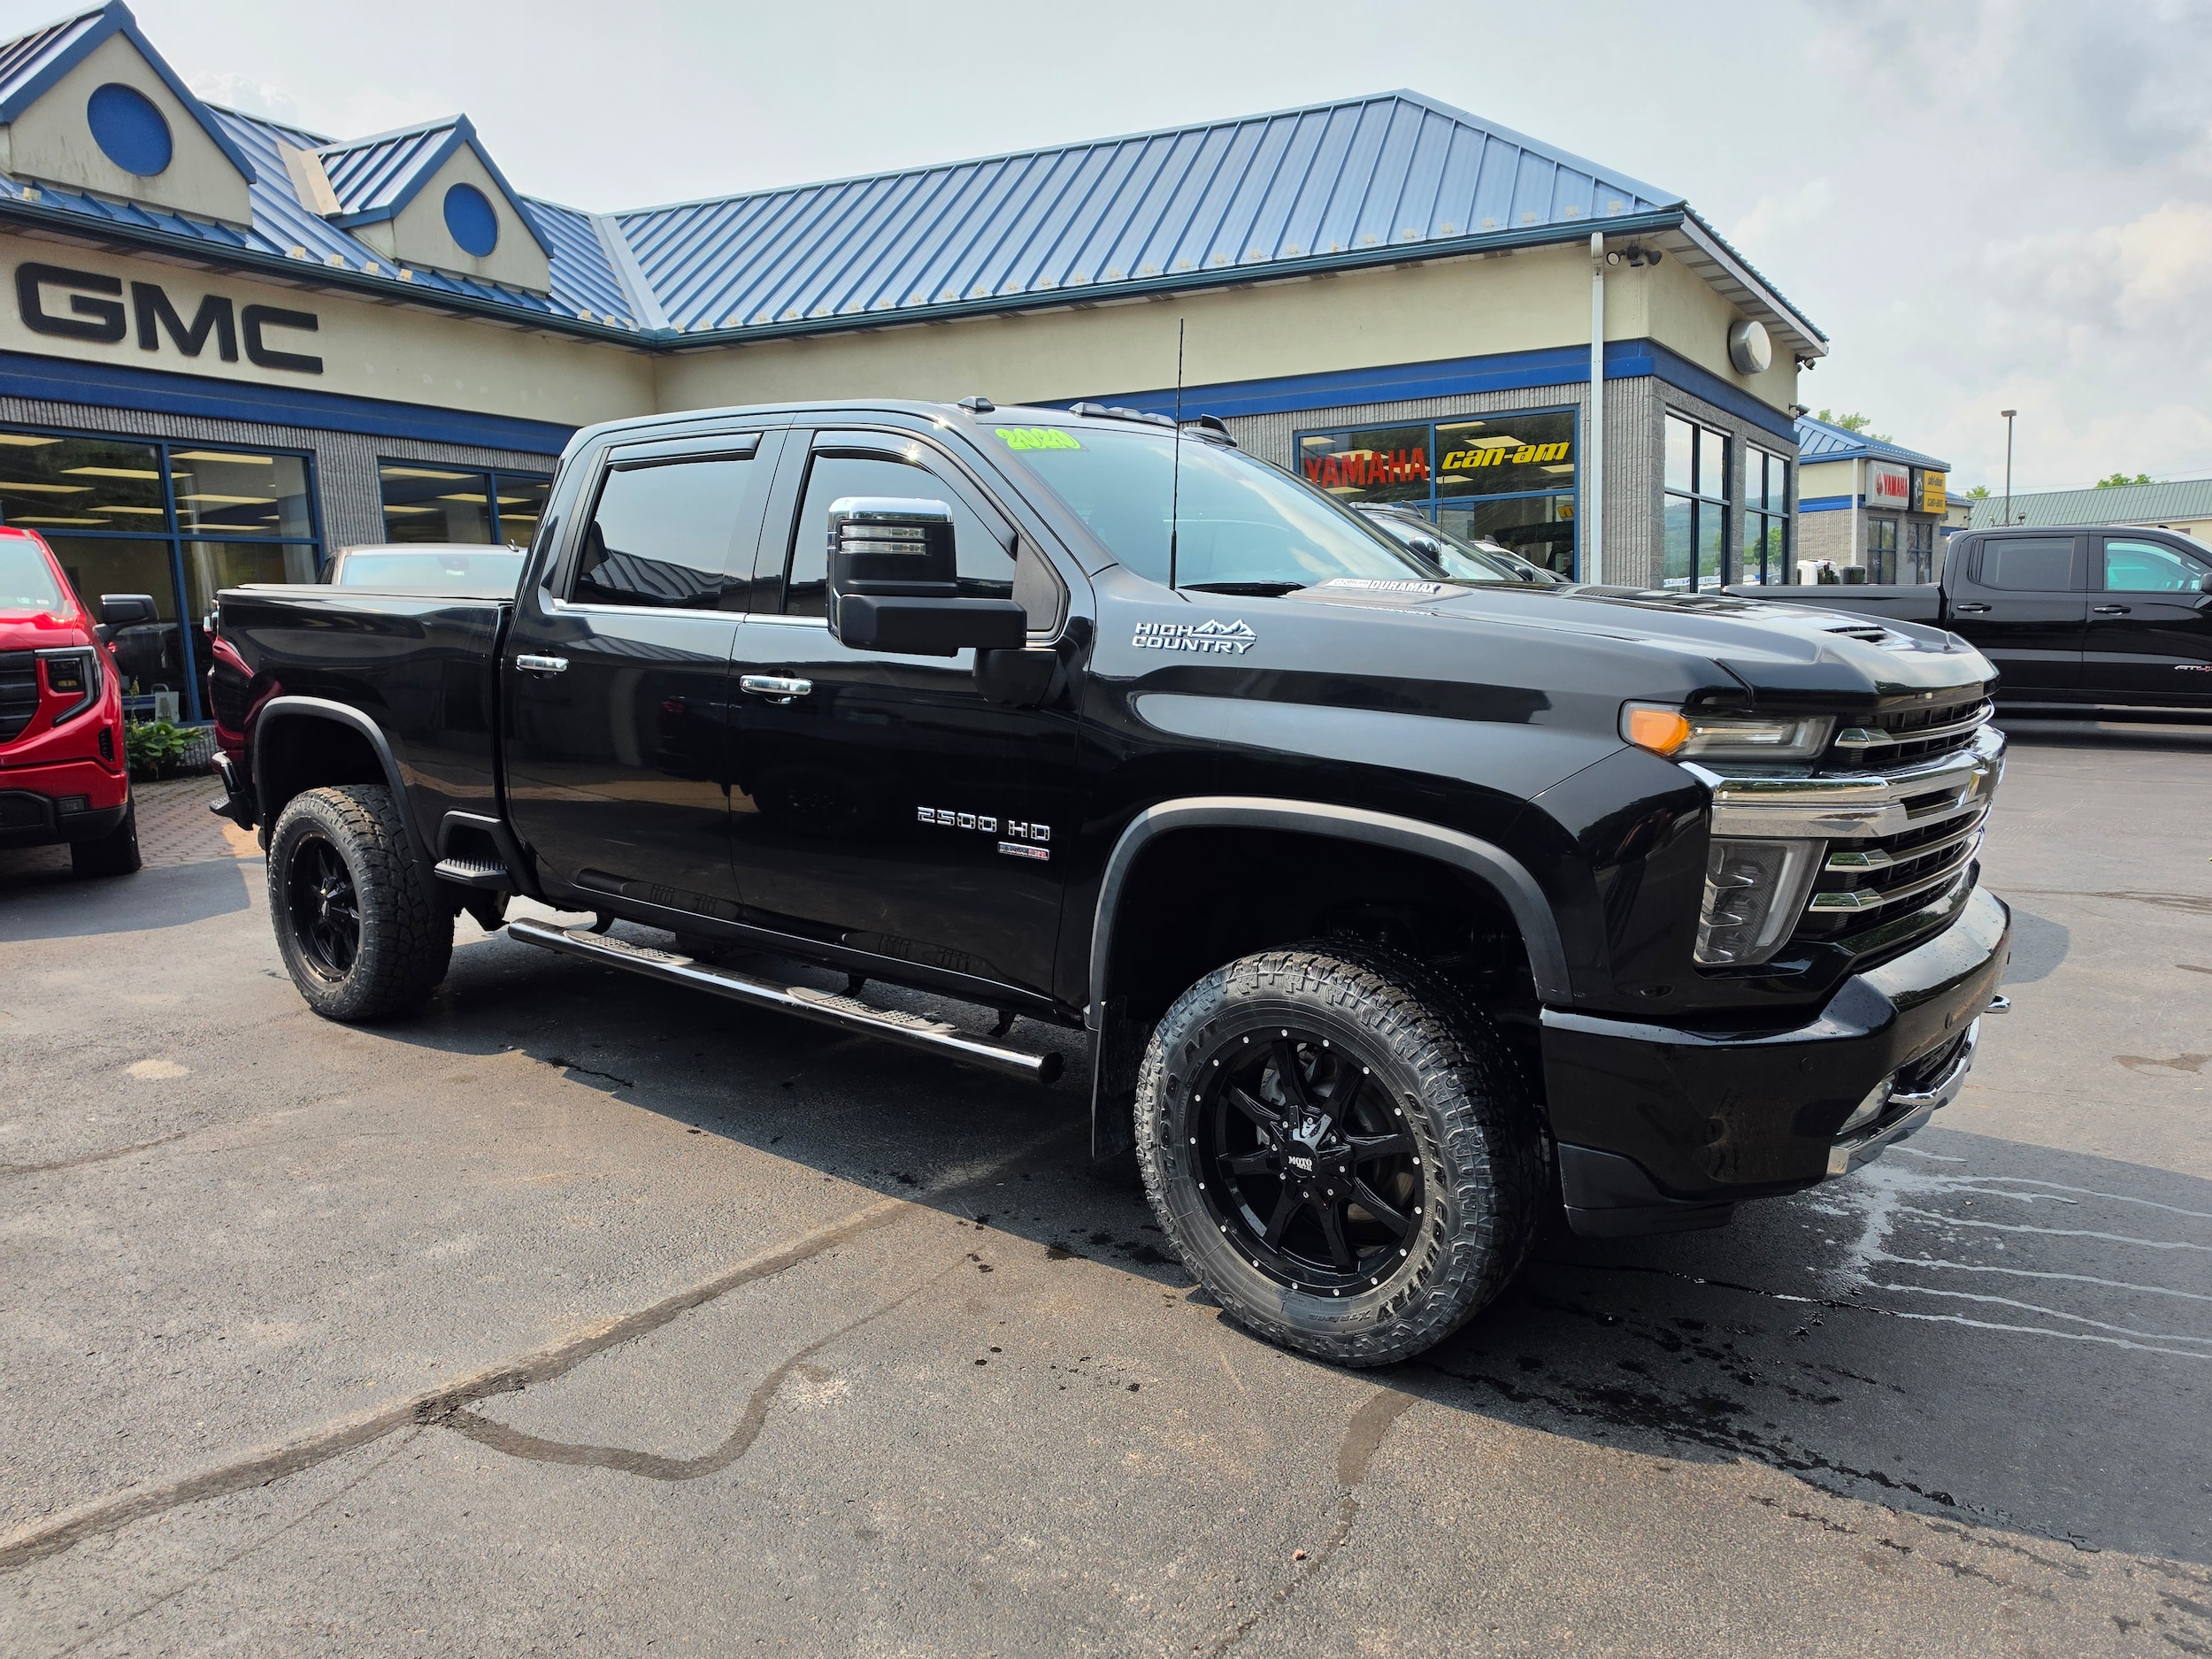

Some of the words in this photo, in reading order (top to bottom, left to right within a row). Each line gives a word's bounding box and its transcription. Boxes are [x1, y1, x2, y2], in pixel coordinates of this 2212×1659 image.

[15, 262, 324, 374] GMC
[995, 428, 1081, 449] 2020
[1305, 447, 1428, 488] YAMAHA
[1441, 442, 1571, 470] can-am
[1884, 473, 1909, 498] YAMAHA
[1369, 580, 1439, 594] DURAMAX
[1134, 622, 1195, 637] HIGH
[1132, 635, 1254, 655] COUNTRY
[917, 806, 997, 833] 2500
[1008, 819, 1051, 841] HD
[1287, 1156, 1313, 1167] MOTO
